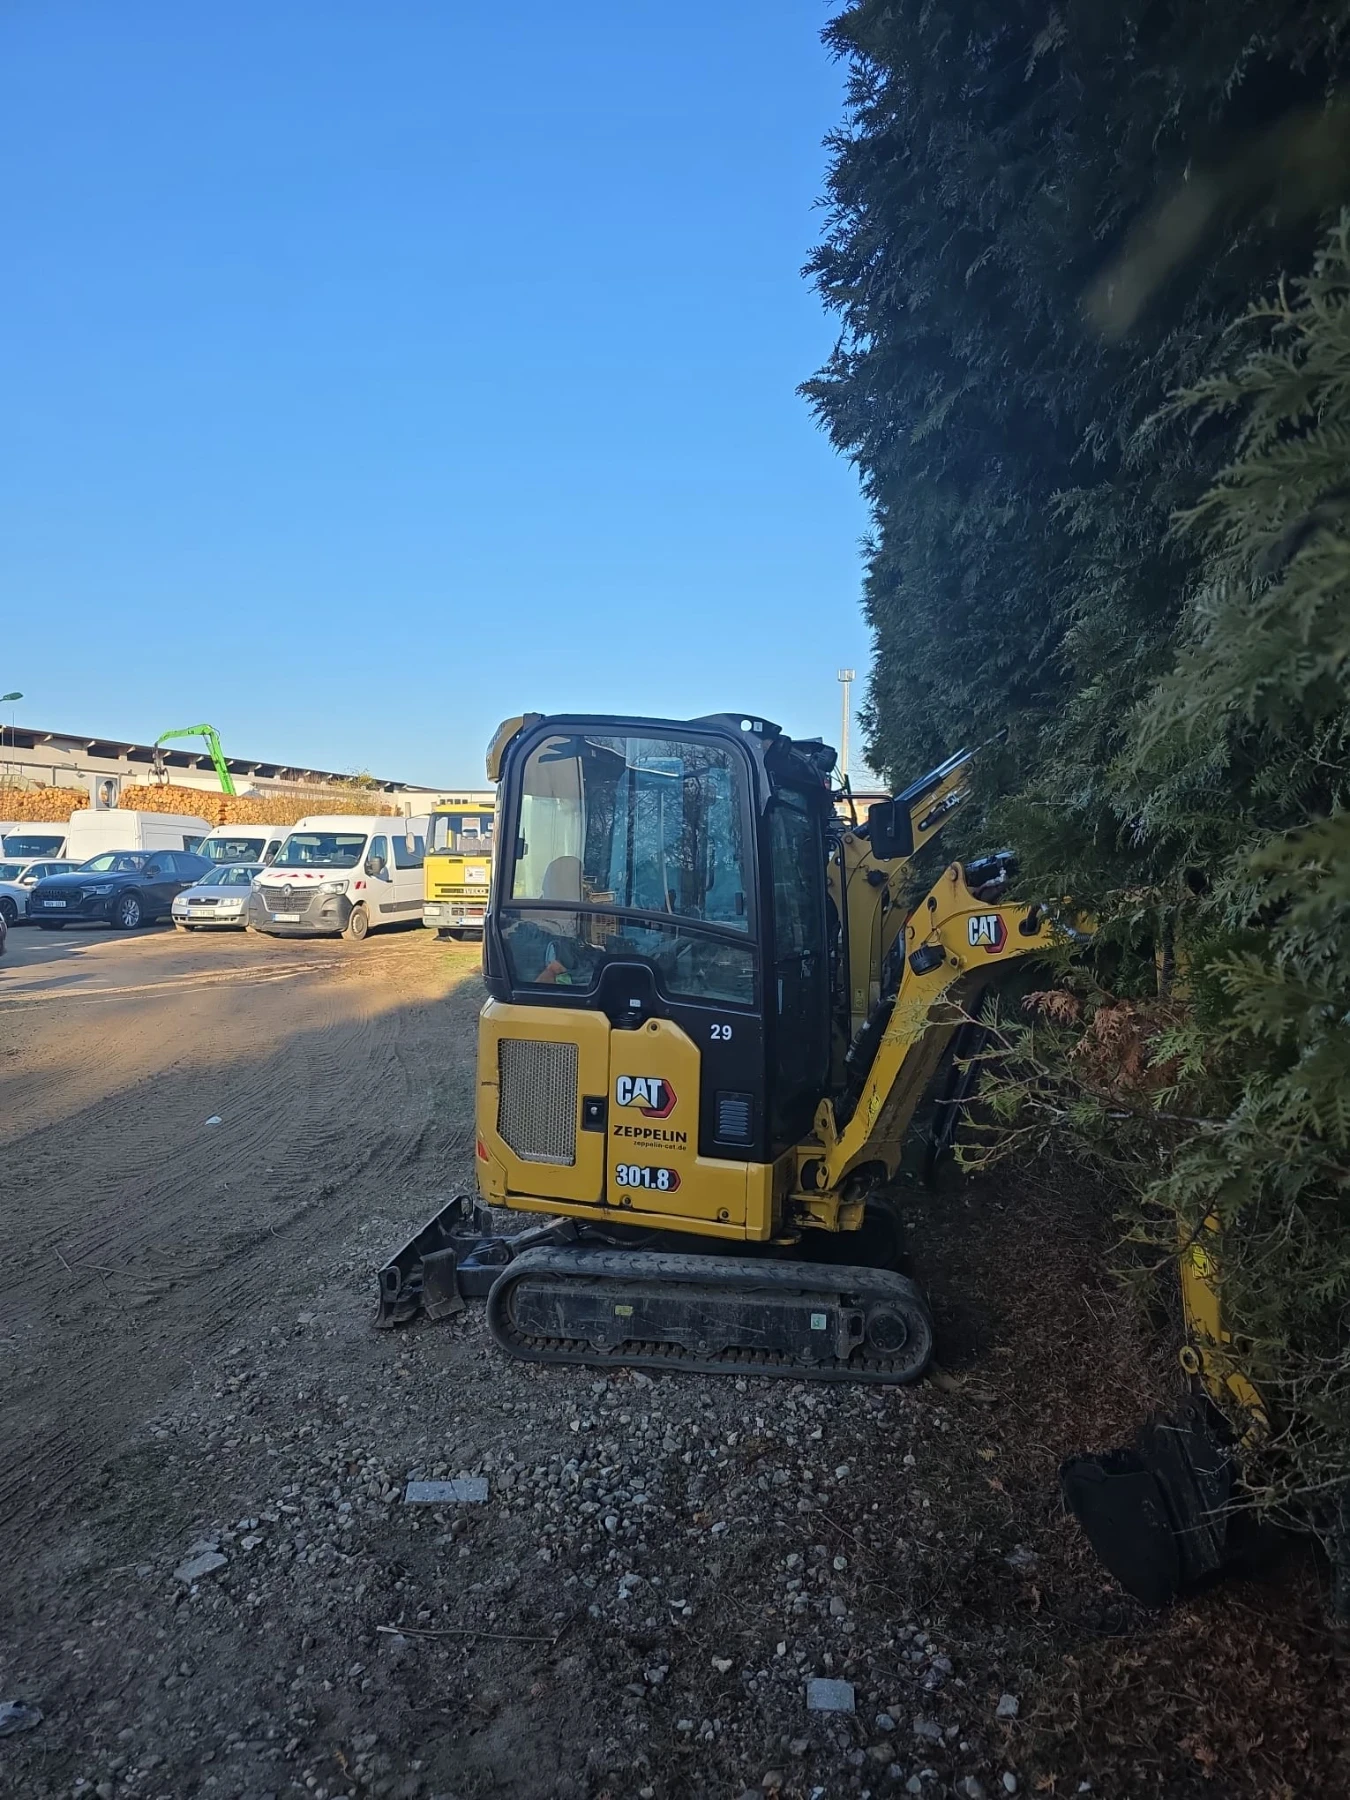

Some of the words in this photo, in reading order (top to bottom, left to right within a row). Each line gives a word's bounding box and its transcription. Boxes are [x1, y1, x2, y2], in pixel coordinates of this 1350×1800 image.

[968, 915, 998, 946] CAT
[710, 1024, 732, 1041] 29
[616, 1076, 662, 1108] CAT
[613, 1125, 687, 1143] ZEPPELIN
[633, 1140, 687, 1151] zeppelin-cat.de
[616, 1164, 669, 1190] 301.8
